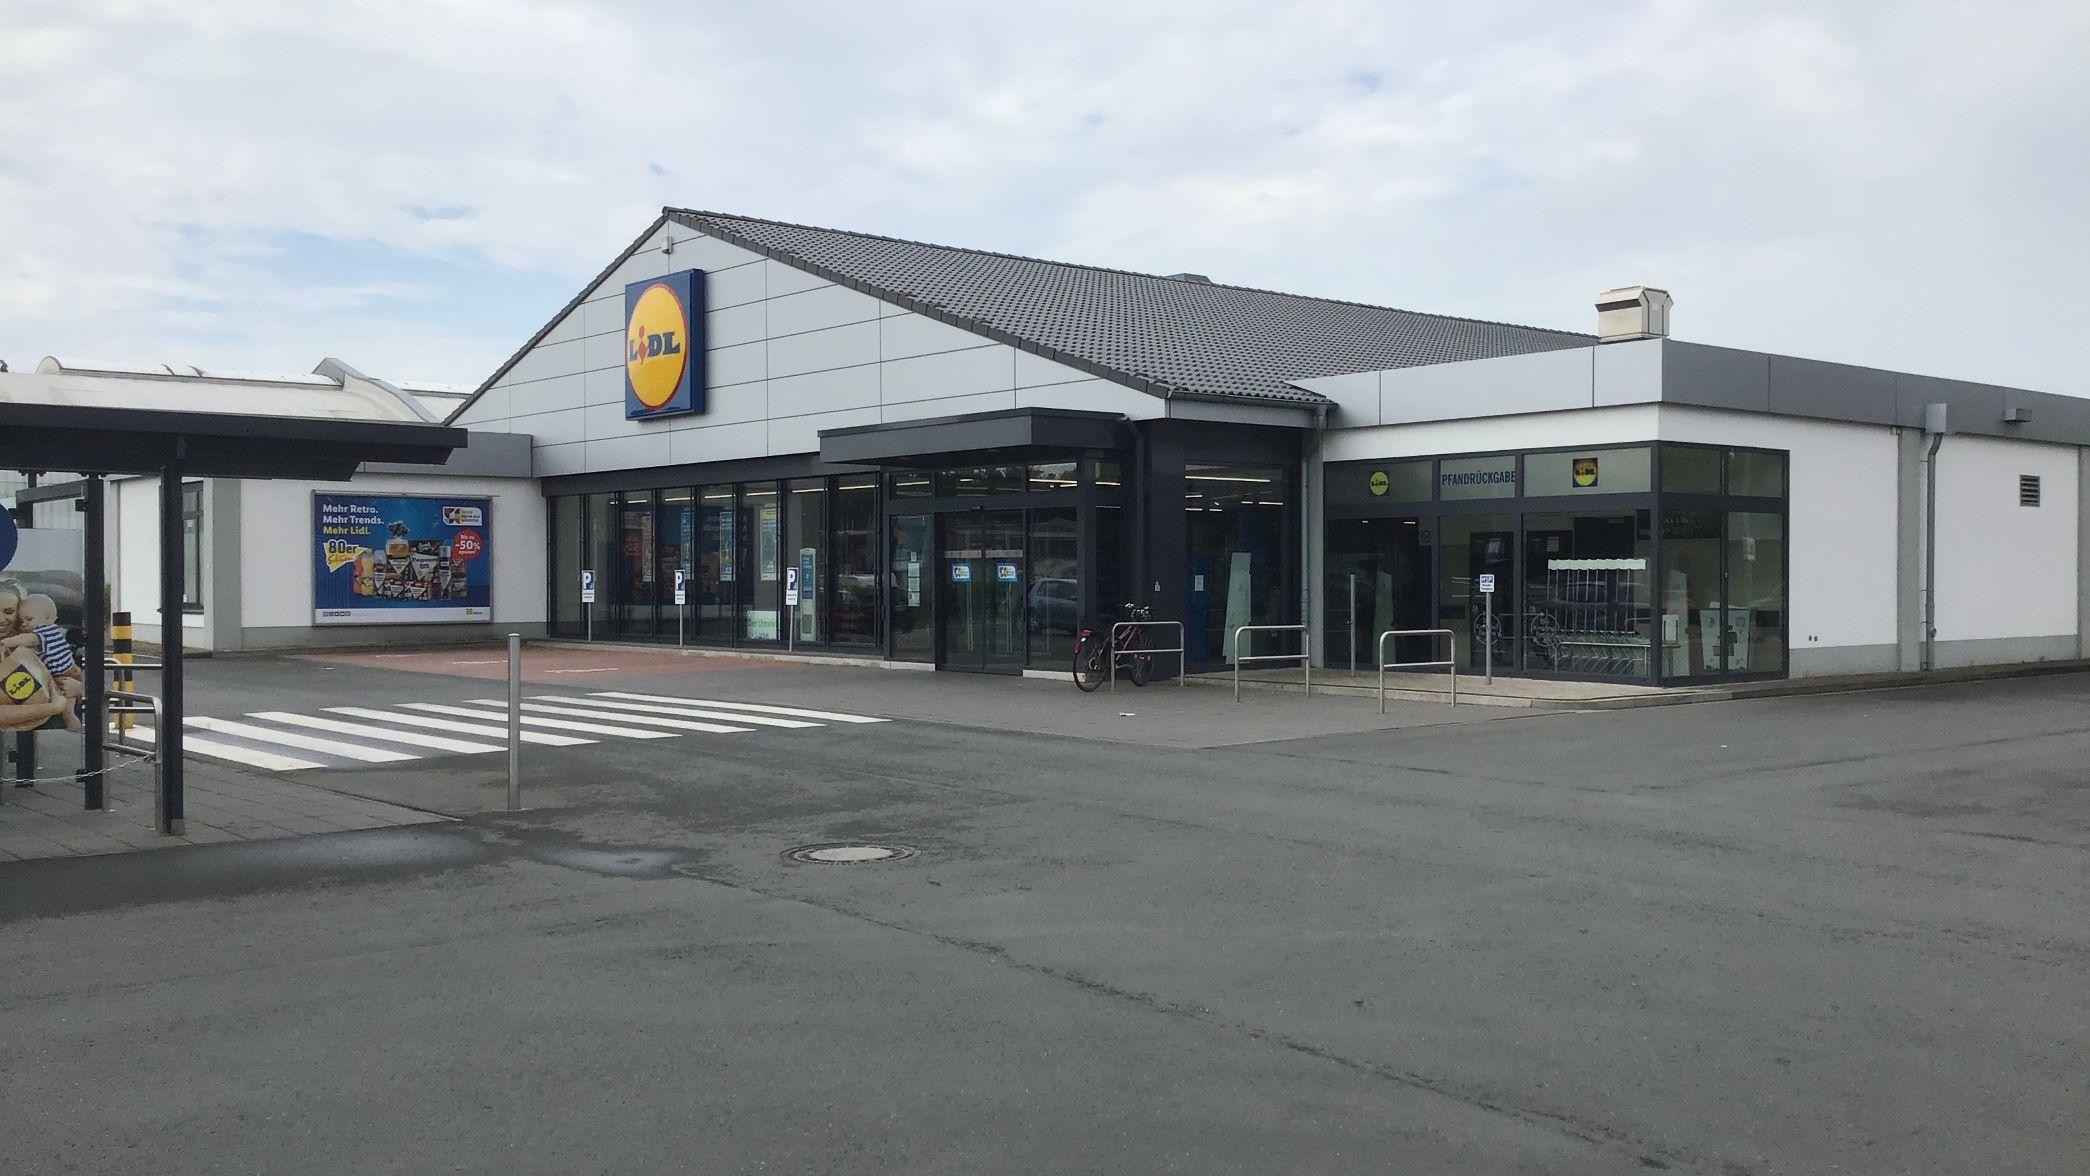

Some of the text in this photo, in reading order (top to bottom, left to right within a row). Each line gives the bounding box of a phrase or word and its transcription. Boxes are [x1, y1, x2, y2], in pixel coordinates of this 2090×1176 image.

[1441, 468, 1517, 486] PFANDRÜCKGABE
[322, 504, 379, 514] Mehr Retro.
[322, 515, 384, 525] Mehr Trends.
[322, 526, 348, 534] Mehr
[328, 539, 358, 554] 80er
[583, 572, 592, 590] P
[675, 571, 683, 590] P
[787, 569, 796, 590] P
